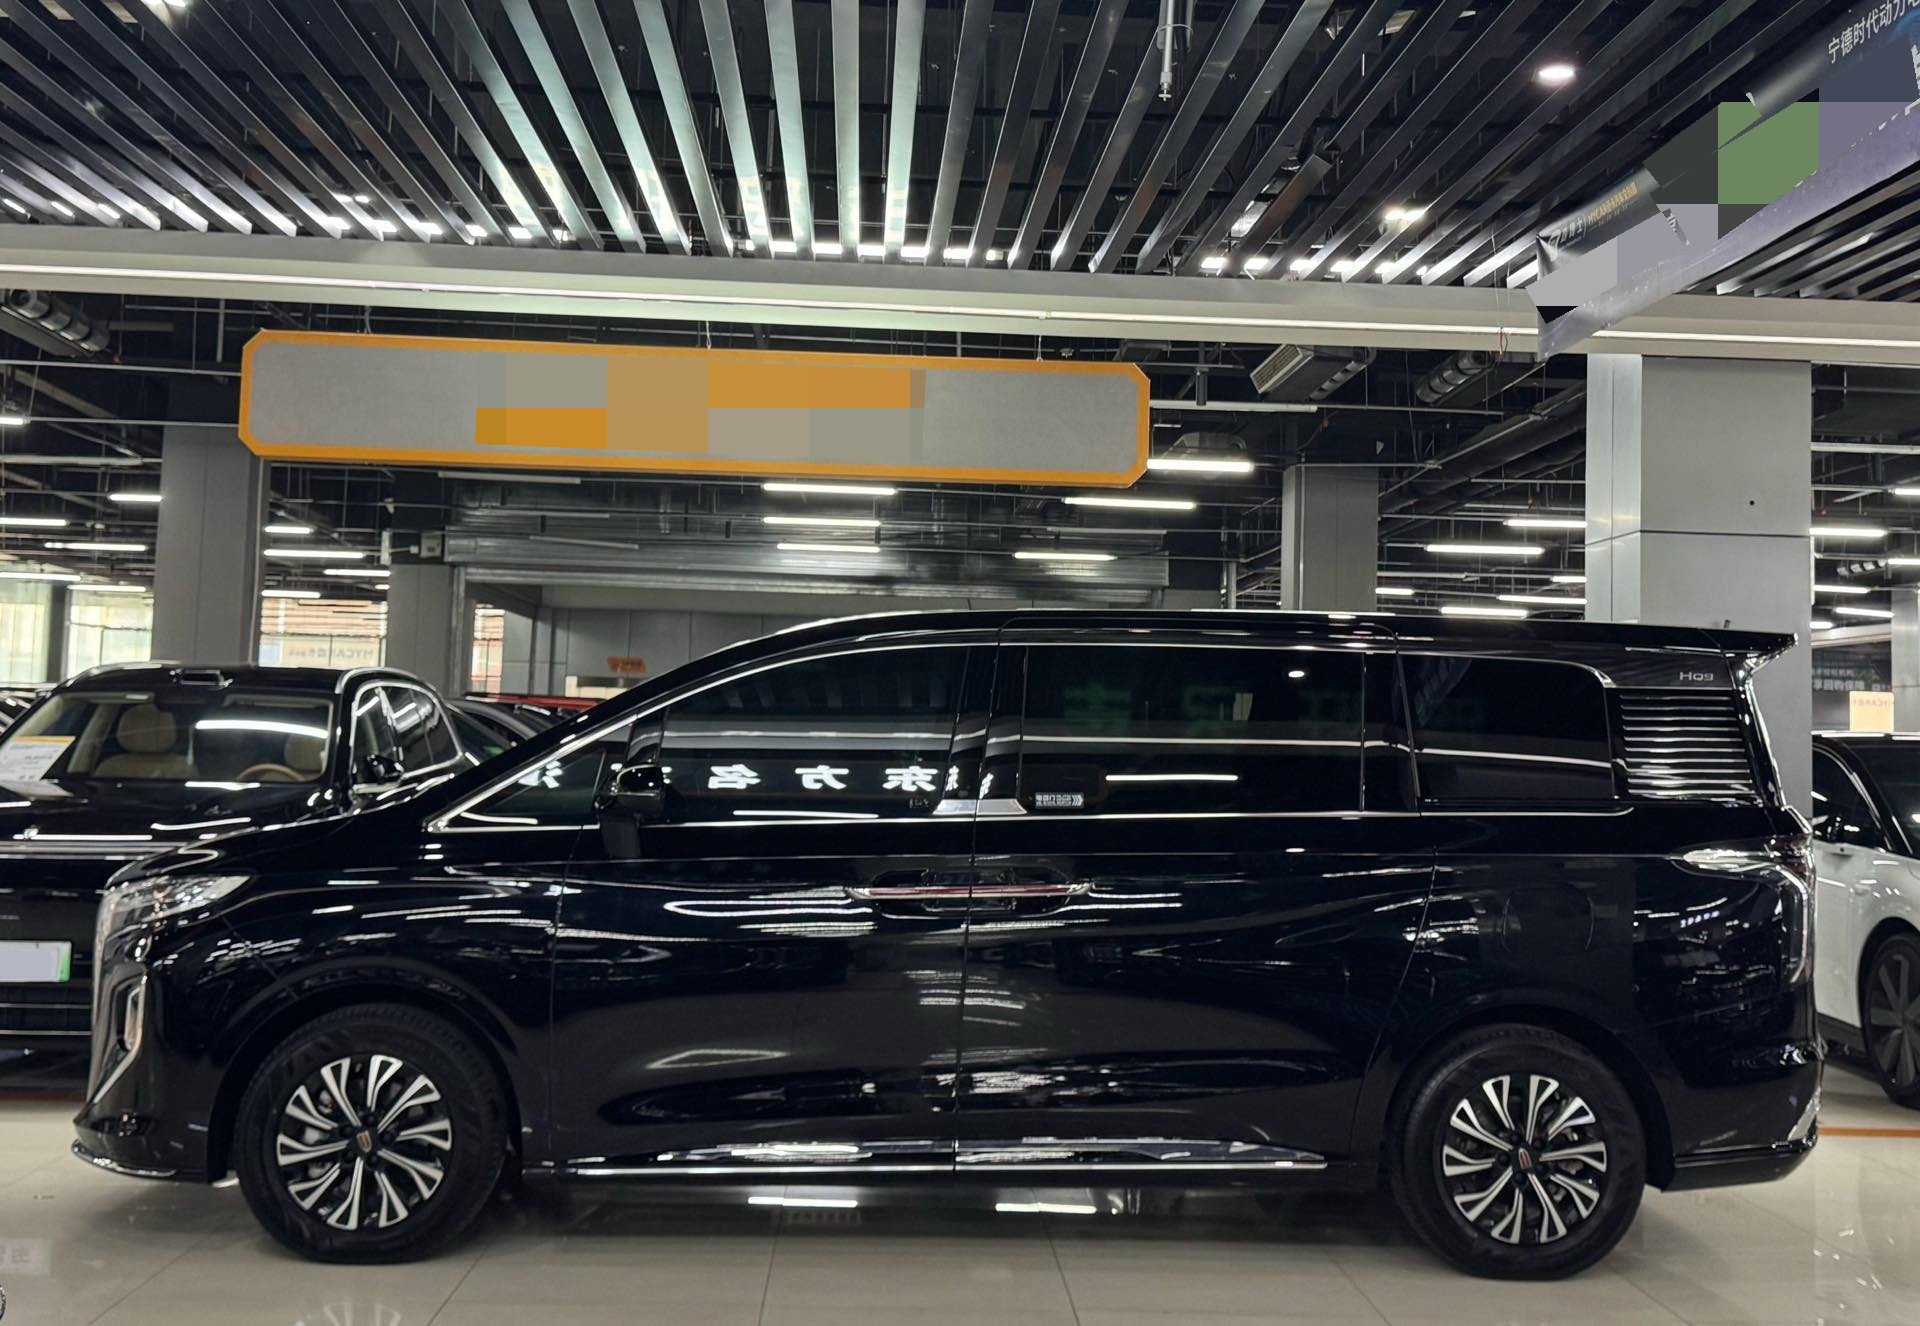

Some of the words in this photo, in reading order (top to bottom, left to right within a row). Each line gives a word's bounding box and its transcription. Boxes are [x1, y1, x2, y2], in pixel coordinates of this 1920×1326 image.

[1828, 0, 1920, 64] 宁德时代动力
